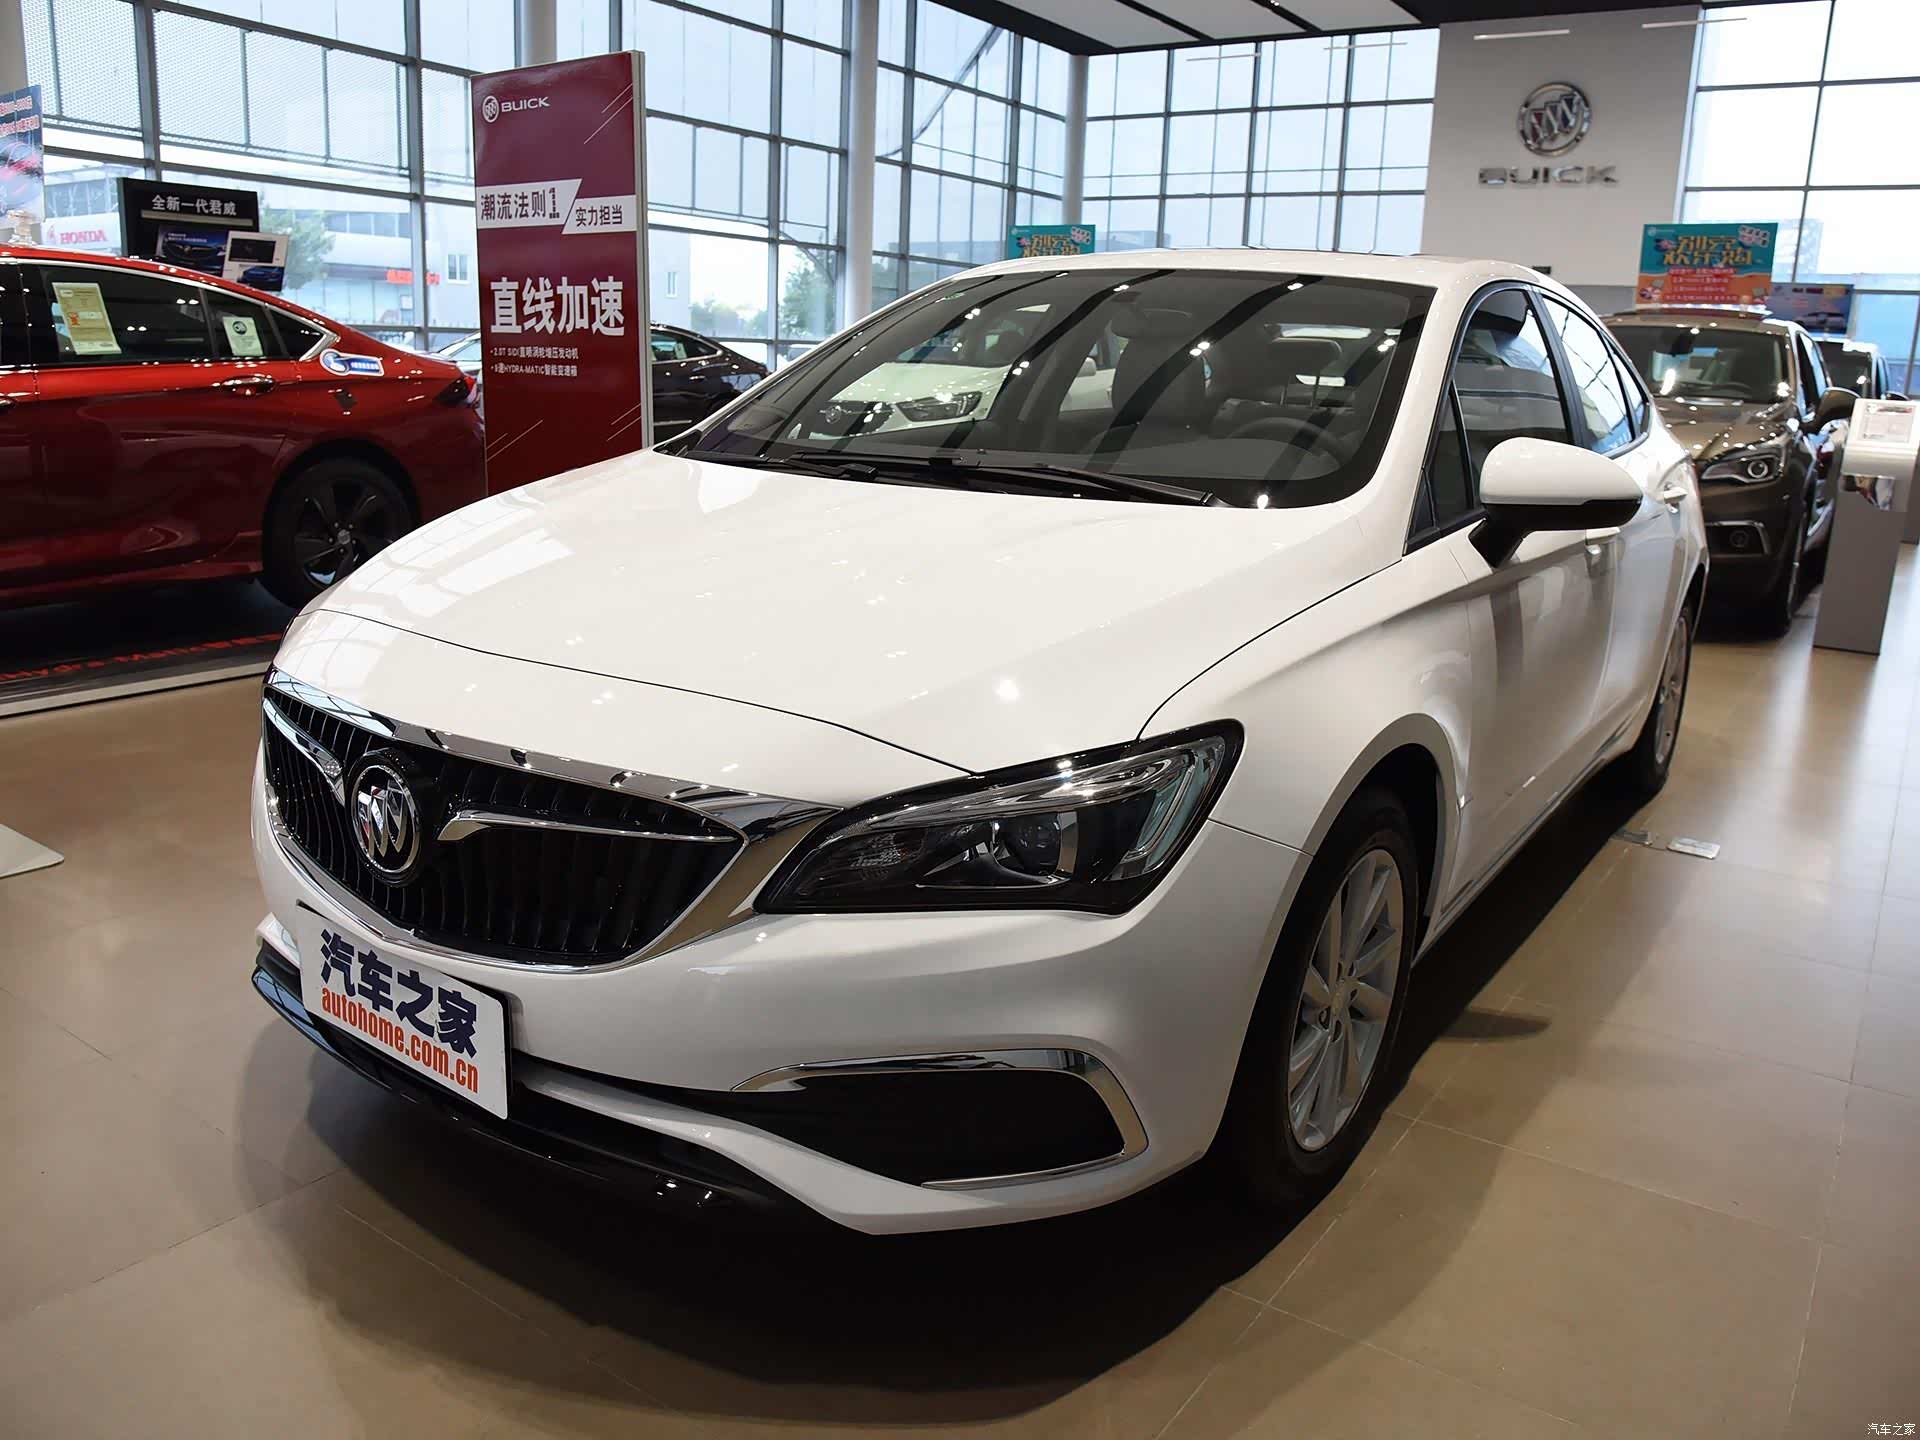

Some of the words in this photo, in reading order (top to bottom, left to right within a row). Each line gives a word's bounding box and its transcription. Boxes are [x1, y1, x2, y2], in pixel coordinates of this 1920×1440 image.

[501, 97, 550, 113] BUICK
[1478, 166, 1618, 185] BUICK
[151, 194, 237, 216] 全新一代君威
[575, 204, 623, 227] 实力担当
[60, 229, 107, 245] HONDA
[490, 275, 624, 336] 直线加速
[320, 928, 478, 1059] 汽车之家
[321, 987, 479, 1094] autohome.com.cn
